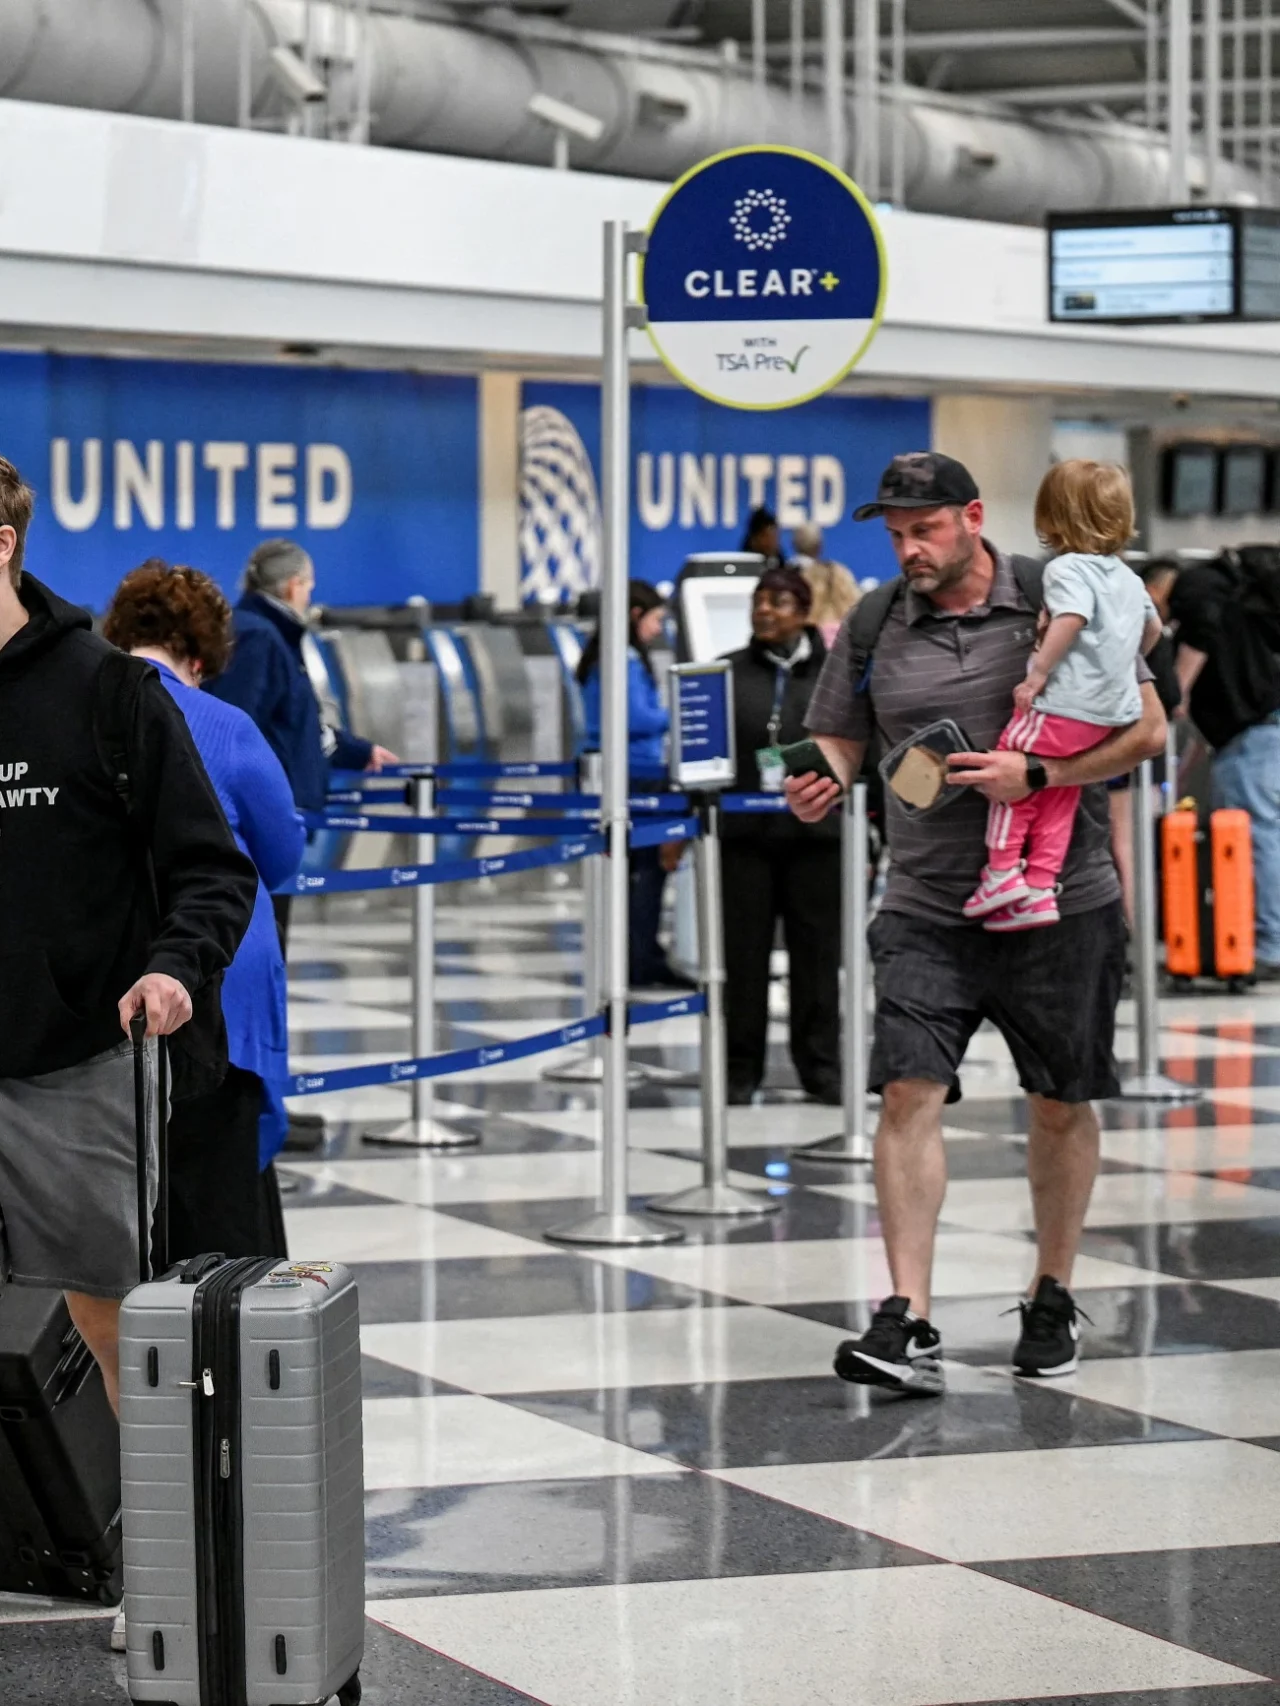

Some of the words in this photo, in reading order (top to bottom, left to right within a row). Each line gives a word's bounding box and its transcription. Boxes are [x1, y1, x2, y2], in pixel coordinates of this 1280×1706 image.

[716, 353, 750, 371] TSA
[742, 337, 777, 348] WITH
[51, 437, 354, 531] UNITED
[637, 451, 846, 531] UNITED
